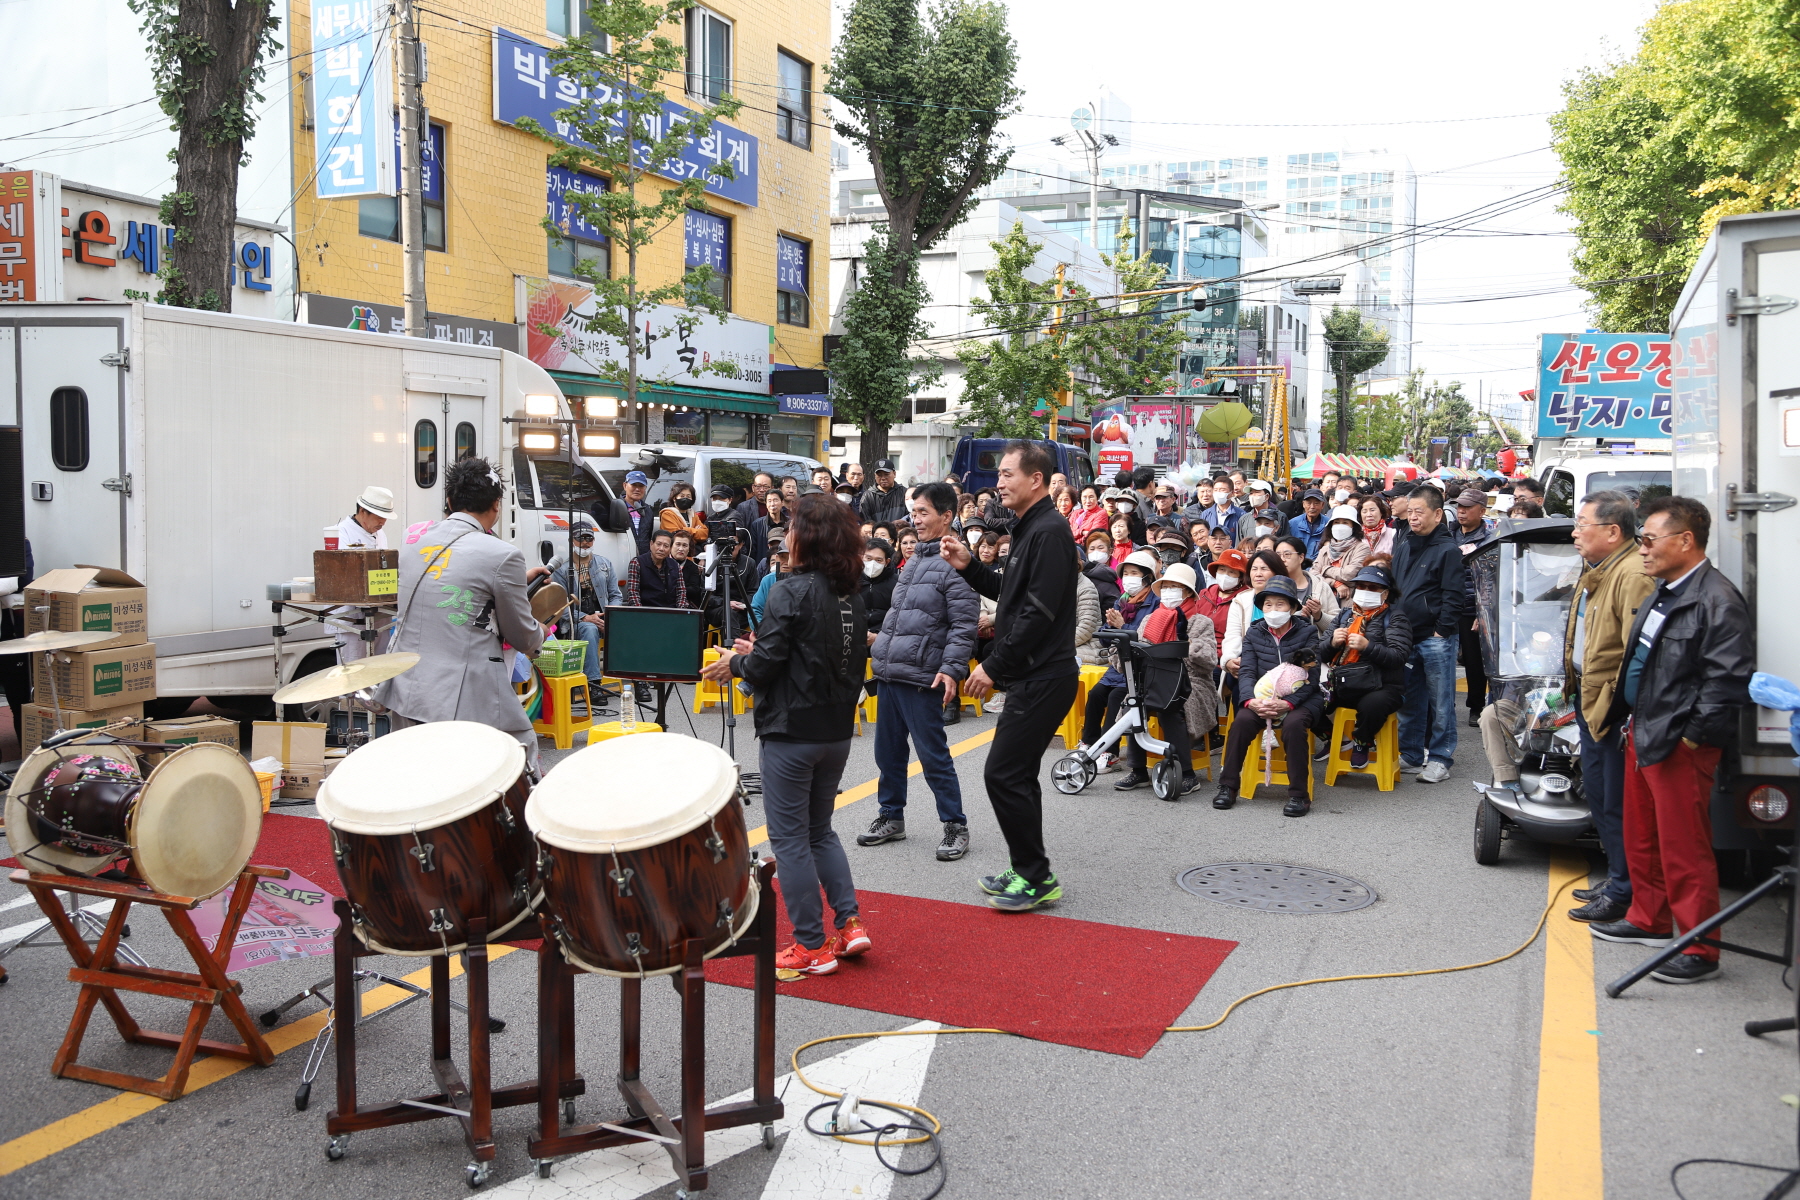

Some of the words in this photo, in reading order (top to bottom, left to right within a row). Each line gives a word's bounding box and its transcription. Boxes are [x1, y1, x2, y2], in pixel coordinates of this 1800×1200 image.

[315, 2, 375, 38] 세무사
[513, 46, 623, 128] 박희건
[326, 43, 365, 187] 박희건
[683, 215, 725, 244] 의·심사·심판
[122, 220, 273, 292] 세인
[1214, 308, 1224, 316] 3F
[388, 316, 494, 348] 복판매점
[792, 397, 823, 411] 906-3337
[113, 603, 144, 615] 미성식품
[124, 659, 153, 673] 미성식품
